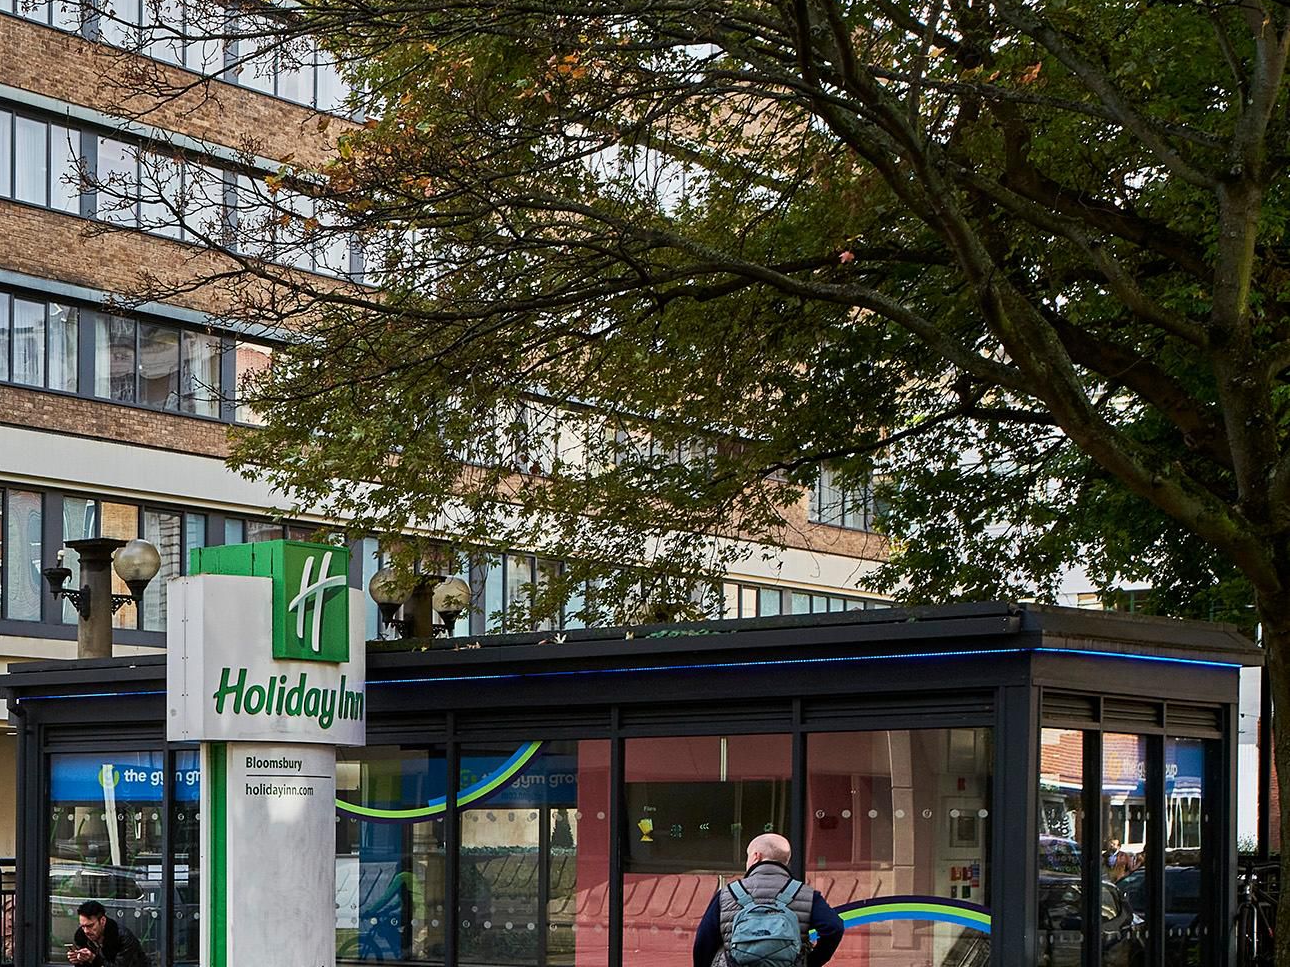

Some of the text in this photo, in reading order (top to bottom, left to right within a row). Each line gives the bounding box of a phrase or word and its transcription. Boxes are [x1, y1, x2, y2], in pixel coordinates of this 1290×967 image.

[213, 667, 364, 730] Holiday Inn
[245, 757, 303, 772] Bloomsbury
[123, 768, 147, 782] the
[245, 783, 314, 798] holidayinn.com
